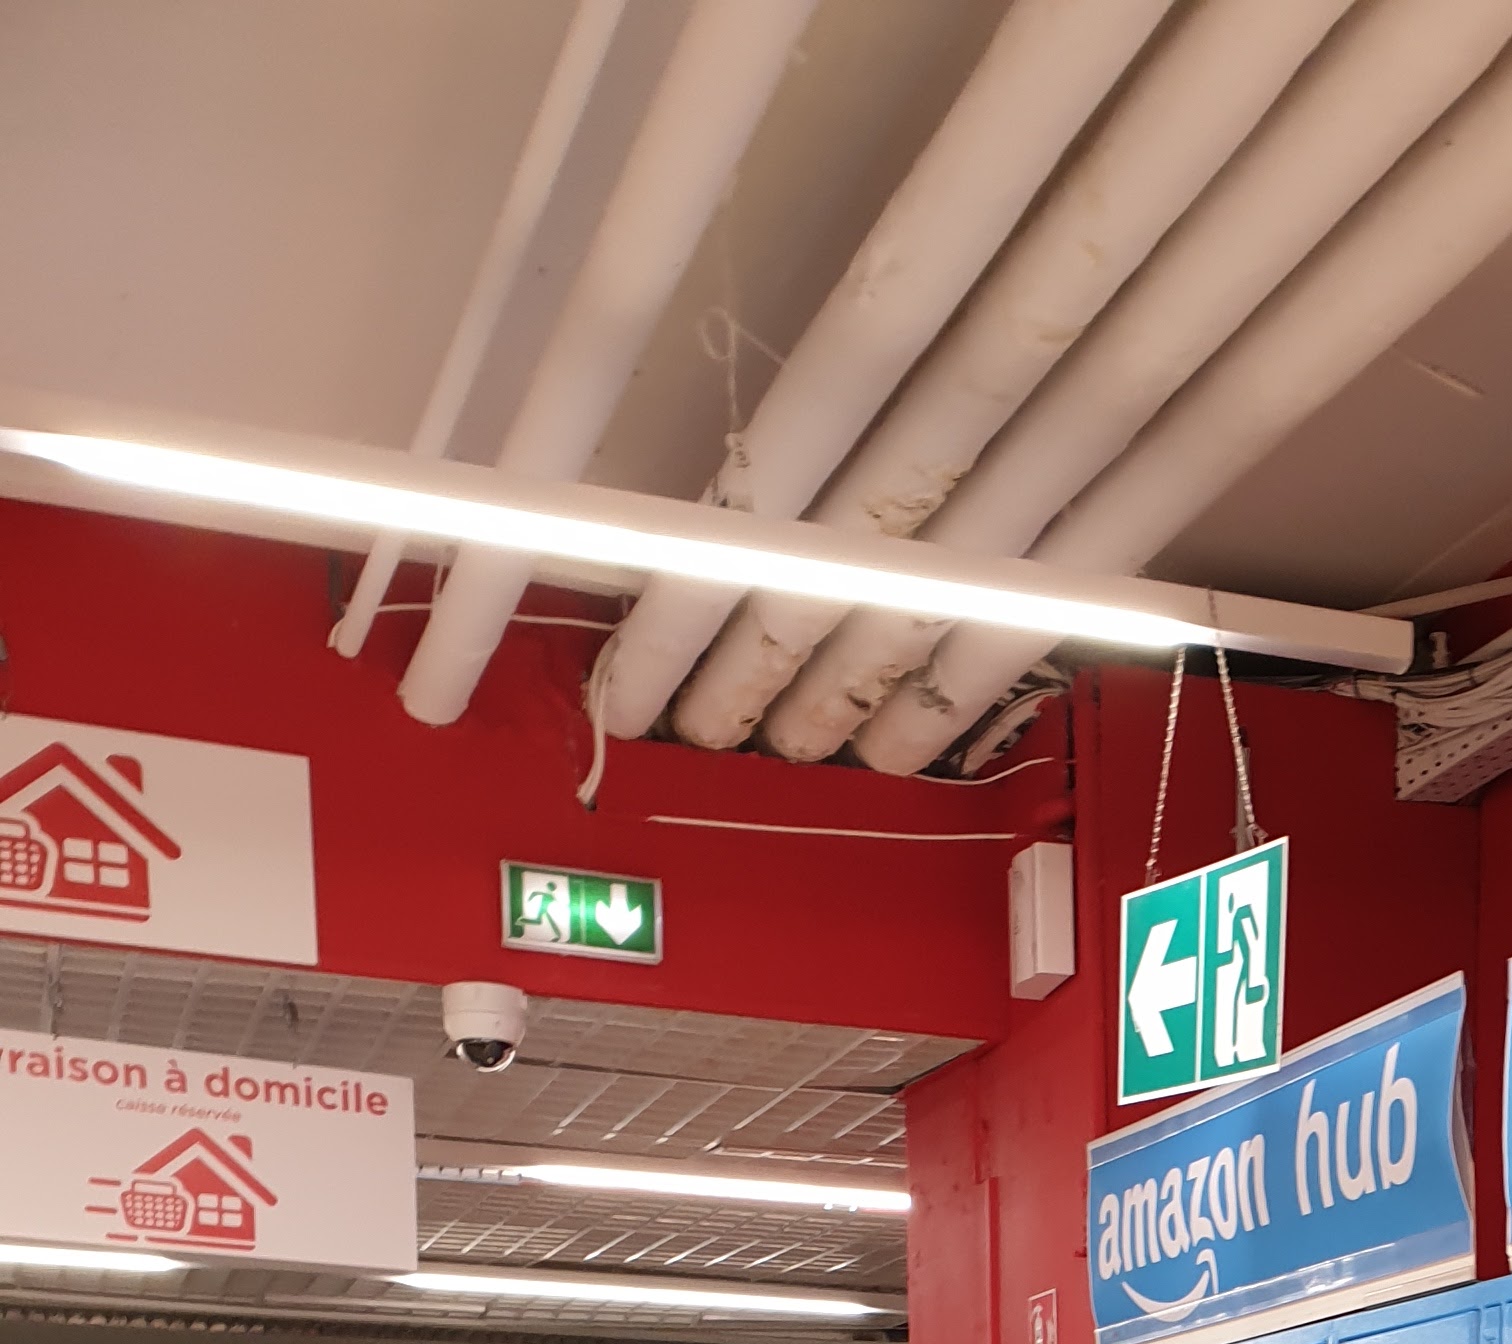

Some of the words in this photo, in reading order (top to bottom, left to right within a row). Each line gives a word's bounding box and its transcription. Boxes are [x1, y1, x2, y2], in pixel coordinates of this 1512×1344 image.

[116, 1098, 167, 1115] caisse
[163, 1059, 189, 1094] à
[204, 1065, 390, 1117] domicile
[1097, 1134, 1270, 1280] amazon
[1295, 1043, 1419, 1216] hub
